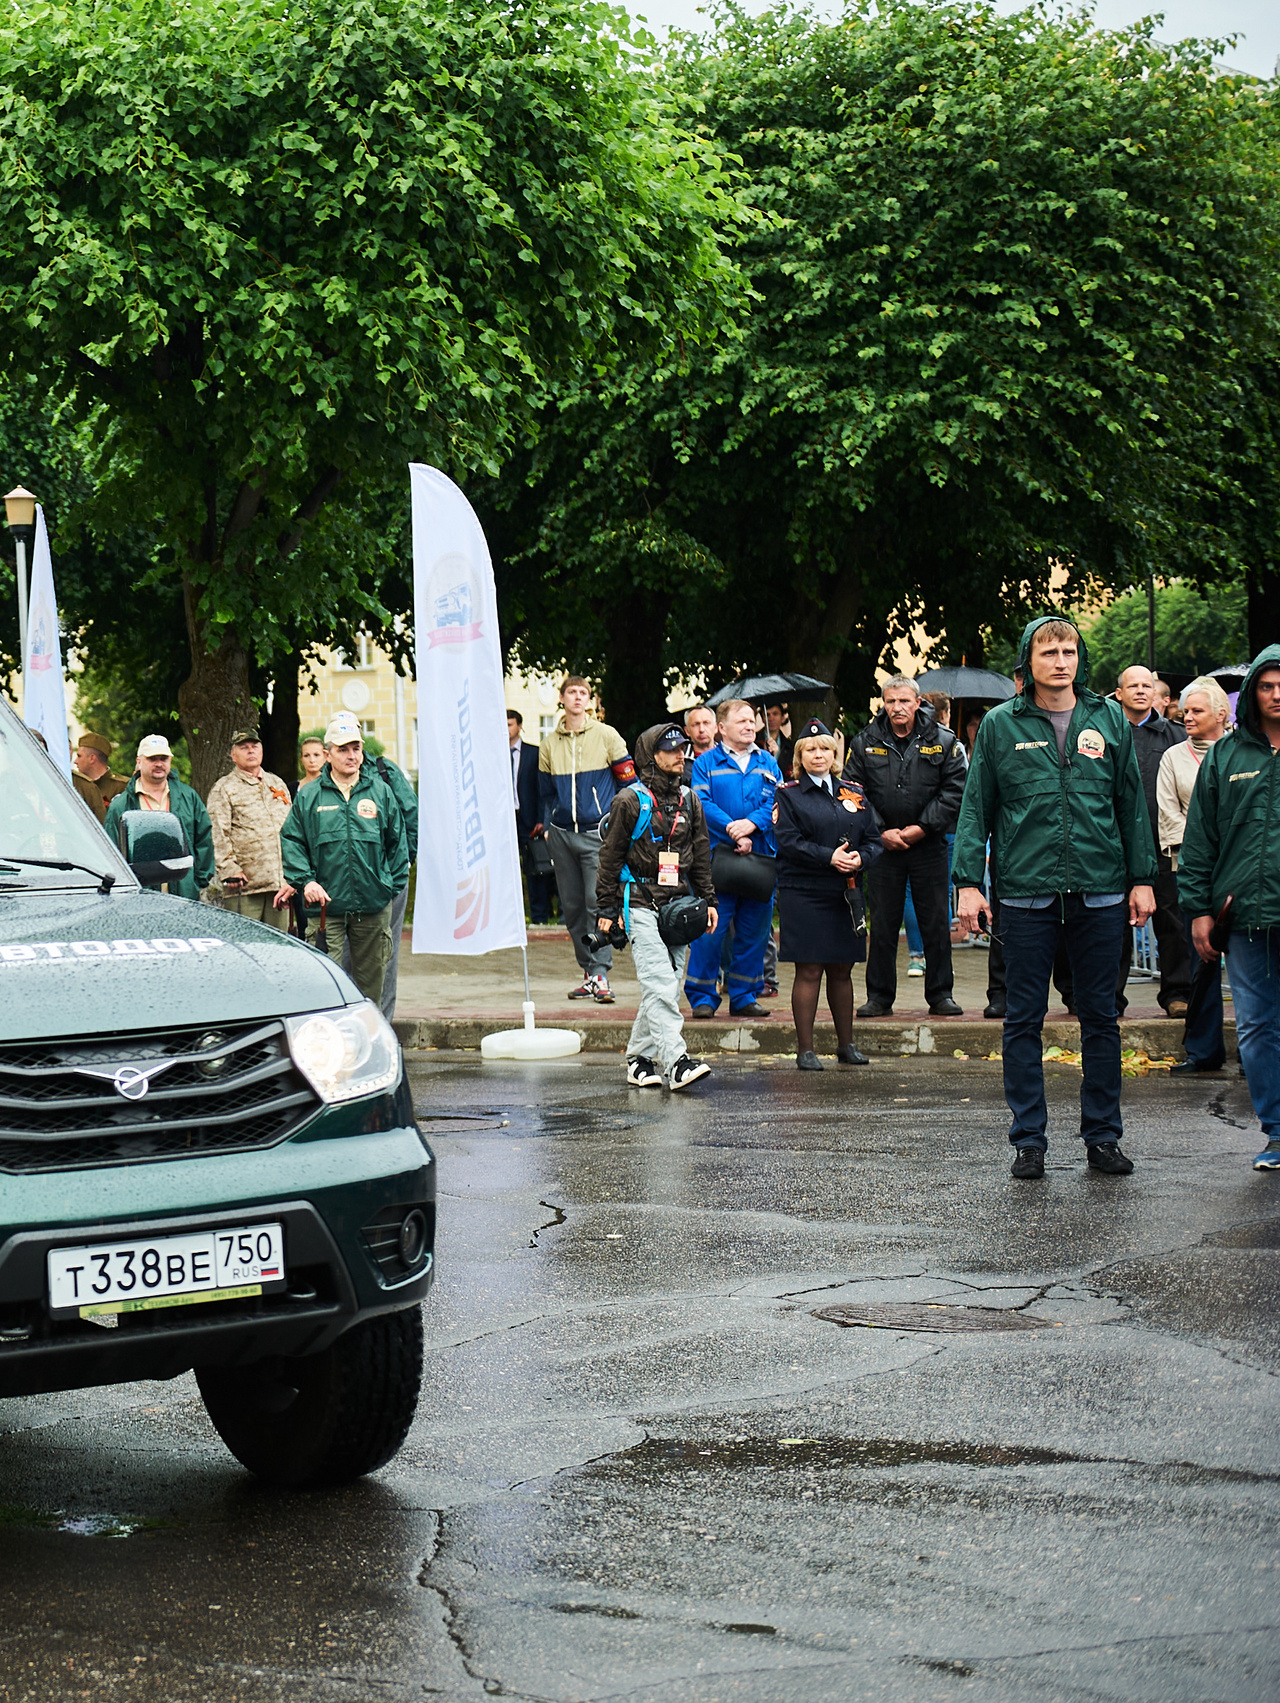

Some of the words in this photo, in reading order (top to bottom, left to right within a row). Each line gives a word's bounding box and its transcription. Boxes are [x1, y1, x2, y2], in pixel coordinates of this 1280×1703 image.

[65, 1248, 211, 1297] Т338ВЕ
[219, 1231, 272, 1267] 750
[232, 1265, 260, 1279] RUS
